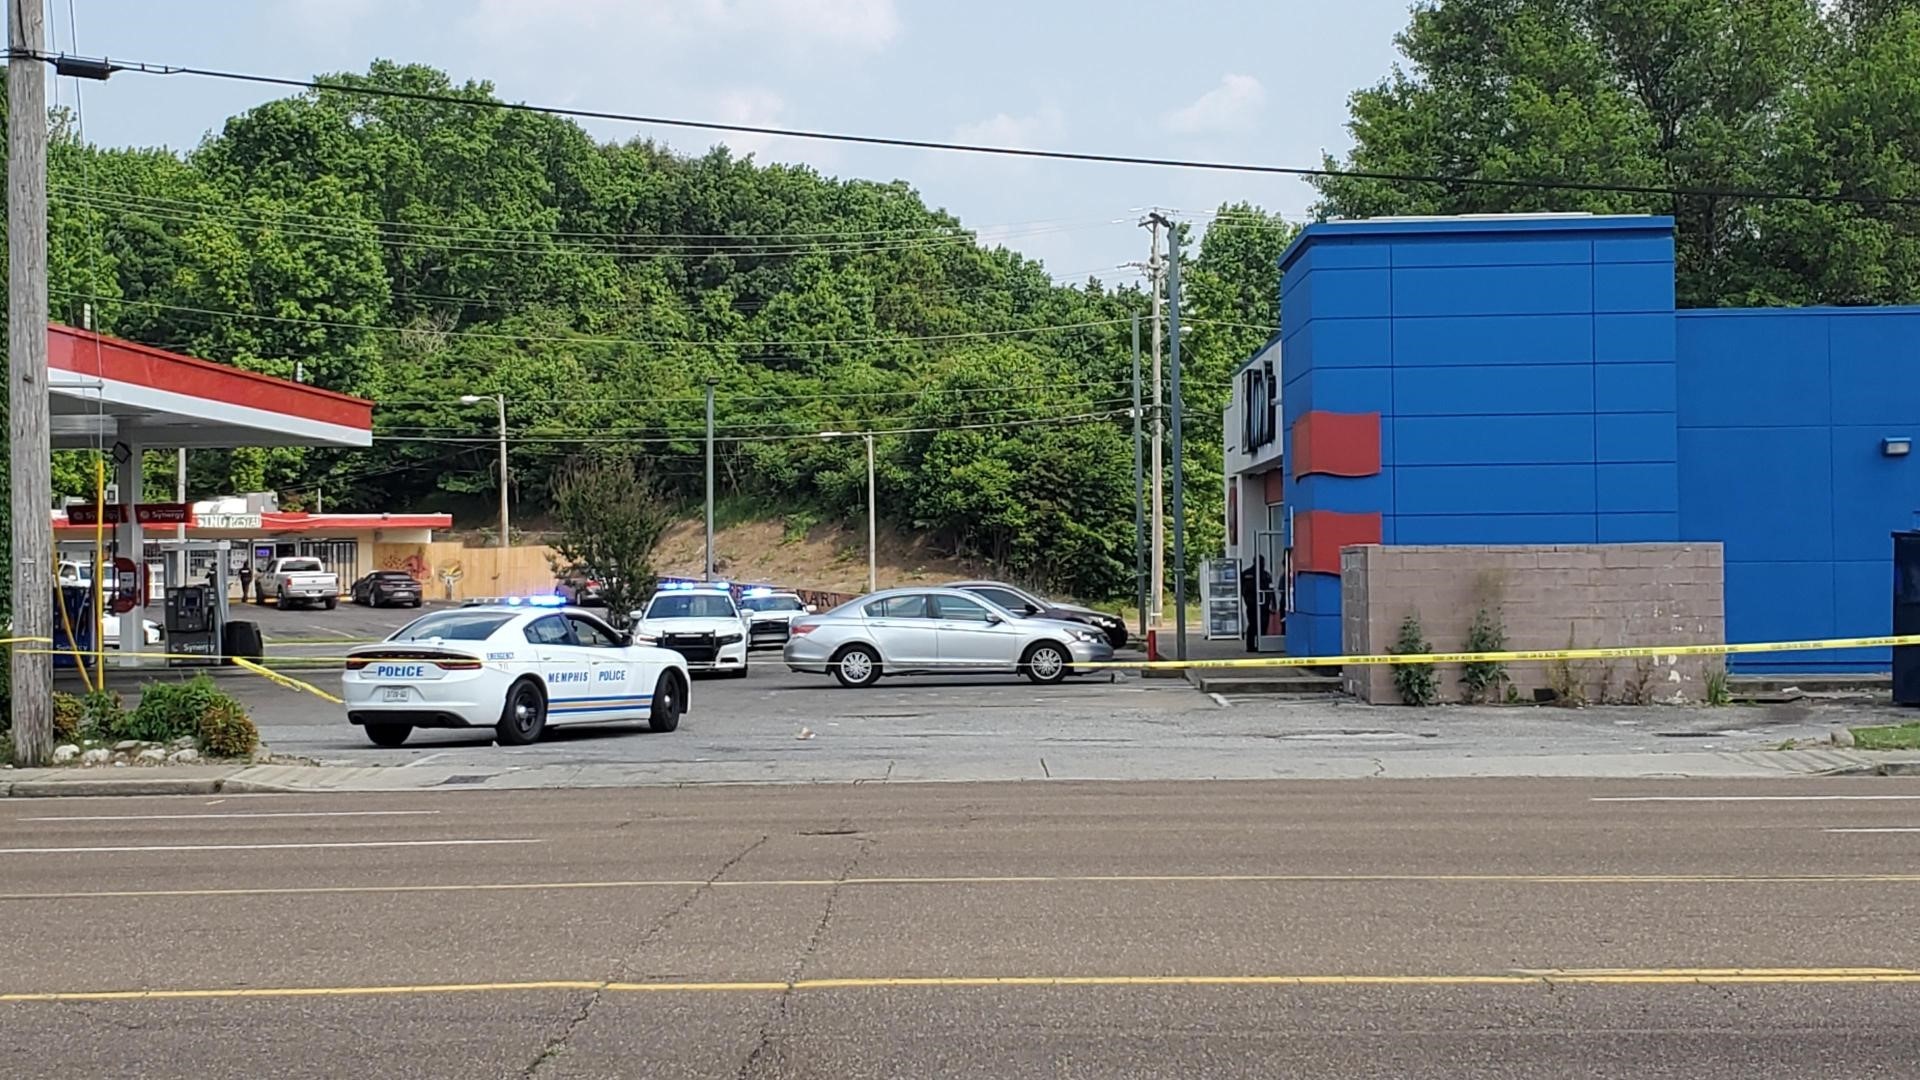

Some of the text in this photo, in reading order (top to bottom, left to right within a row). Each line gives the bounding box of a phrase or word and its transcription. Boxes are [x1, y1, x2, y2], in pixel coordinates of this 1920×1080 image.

[151, 510, 185, 520] Synergy
[377, 665, 425, 677] POLICE
[547, 669, 626, 683] MEMPHIS POLICE
